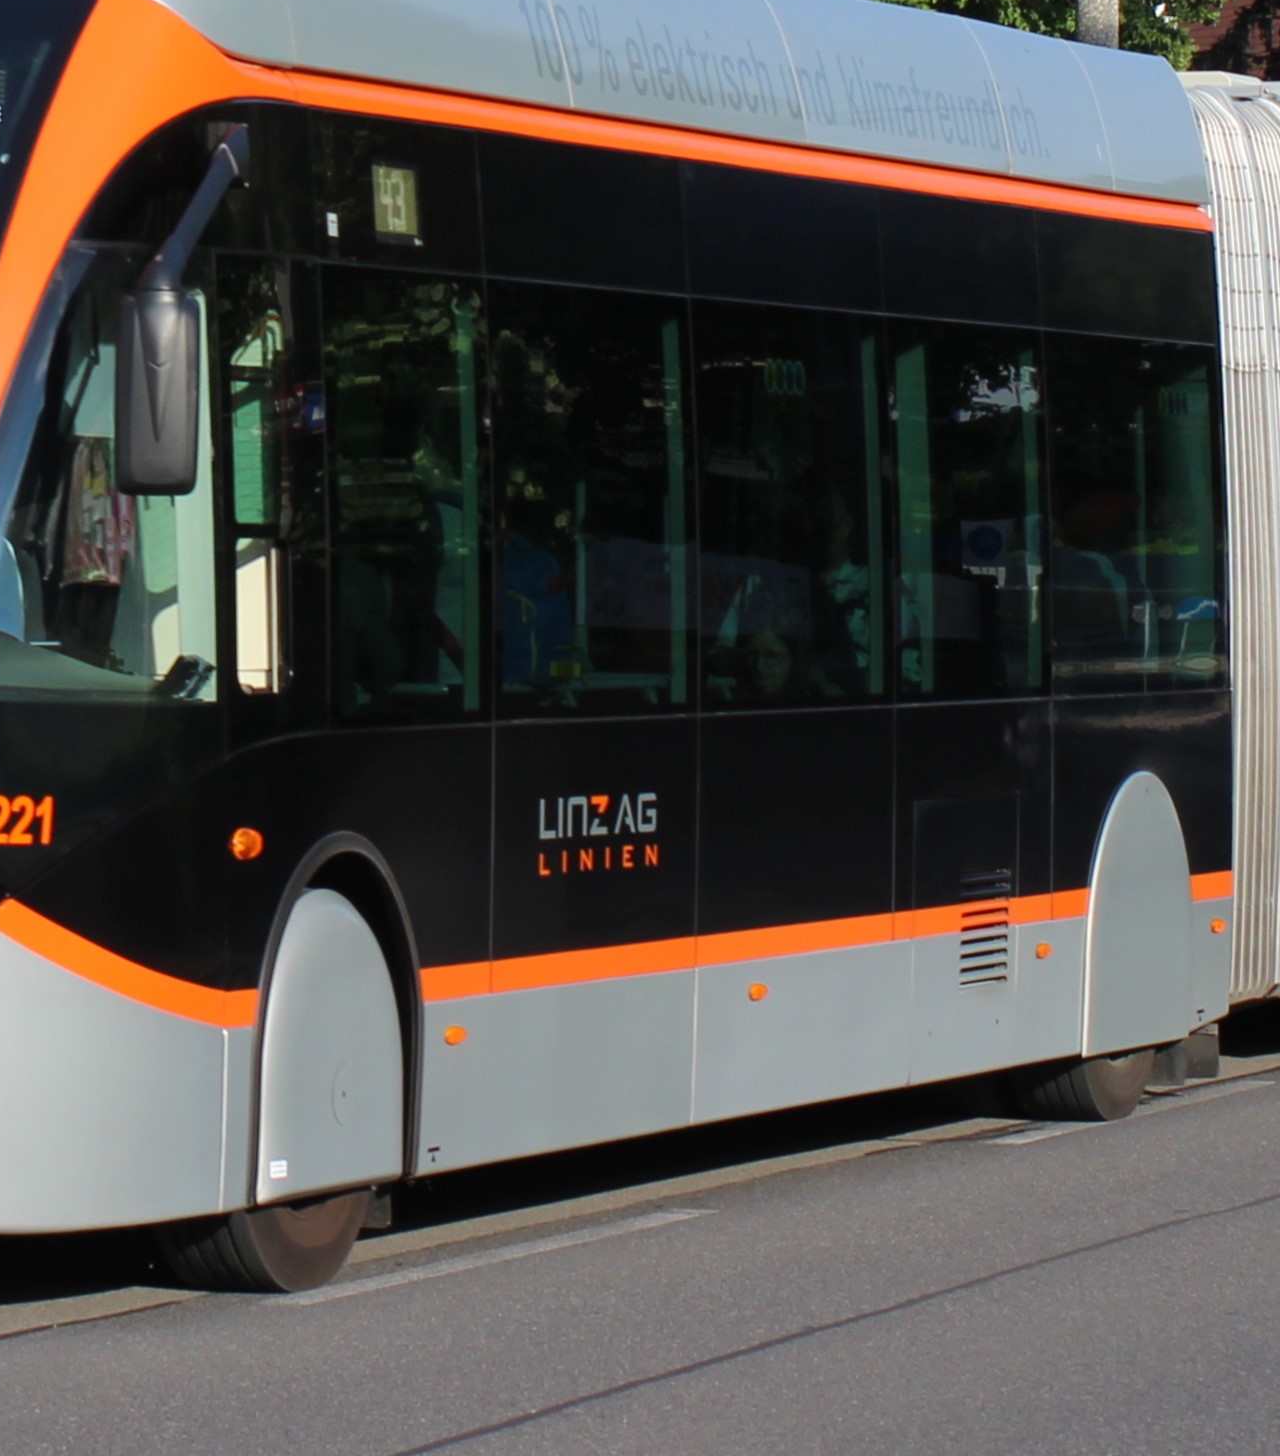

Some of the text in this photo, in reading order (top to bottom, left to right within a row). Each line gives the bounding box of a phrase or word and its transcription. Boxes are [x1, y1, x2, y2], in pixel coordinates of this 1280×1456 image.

[625, 17, 778, 117] elektrisch
[778, 48, 837, 126] und
[378, 167, 407, 232] 43
[538, 792, 658, 840] LINZ AG
[537, 844, 659, 877] LINIEN
